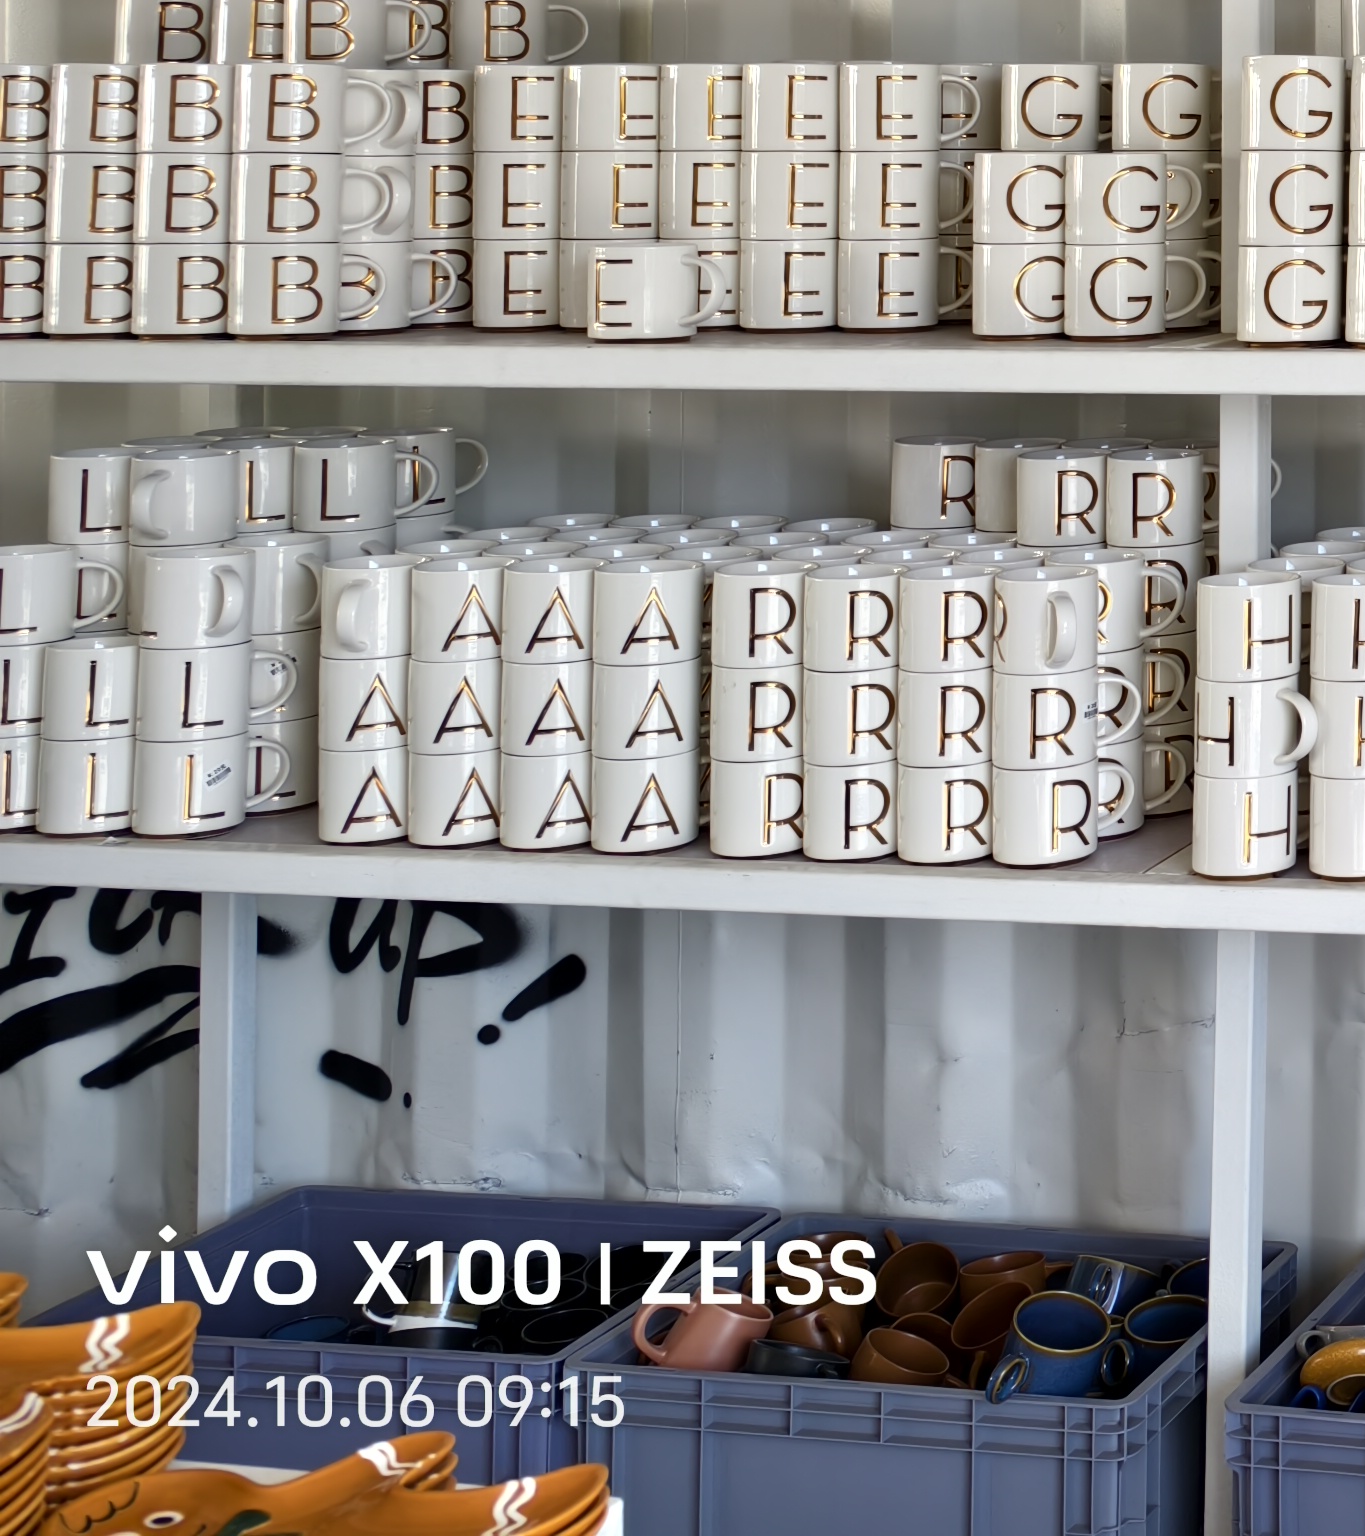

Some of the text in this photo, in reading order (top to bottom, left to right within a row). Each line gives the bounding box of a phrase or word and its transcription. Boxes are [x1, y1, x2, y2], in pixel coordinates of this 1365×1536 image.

[158, 2, 206, 62] B
[484, 0, 529, 62] B
[2, 74, 50, 142] B
[169, 74, 222, 142] B
[268, 74, 318, 142] B
[510, 76, 554, 140] E
[788, 76, 828, 139] E
[877, 76, 918, 140] E
[1021, 76, 1082, 140] G
[1143, 75, 1202, 139] G
[1269, 69, 1332, 138] G
[166, 165, 219, 232] B
[502, 164, 546, 228] E
[611, 164, 652, 228] E
[1006, 165, 1064, 232] G
[1103, 166, 1159, 232] G
[177, 256, 227, 324] B
[272, 256, 322, 324] B
[504, 251, 548, 315] E
[597, 259, 632, 327] E
[783, 252, 824, 316] E
[1013, 256, 1064, 323] G
[1090, 257, 1152, 324] G
[1264, 260, 1327, 330] G
[81, 469, 121, 533] L
[244, 460, 285, 523] L
[322, 459, 360, 521] L
[1056, 470, 1099, 536] R
[1132, 472, 1176, 538] R
[525, 587, 585, 653] A
[620, 588, 679, 654] A
[749, 588, 797, 657] R
[941, 590, 988, 662] R
[1243, 594, 1292, 669] H
[86, 660, 129, 727] L
[182, 662, 224, 728] L
[433, 677, 493, 744] A
[626, 680, 684, 749] A
[849, 683, 896, 754] R
[1030, 688, 1077, 759] R
[88, 753, 129, 819] L
[184, 755, 225, 820] L
[341, 767, 402, 834] A
[621, 774, 680, 843] A
[844, 779, 890, 849] R
[1052, 780, 1092, 852] R
